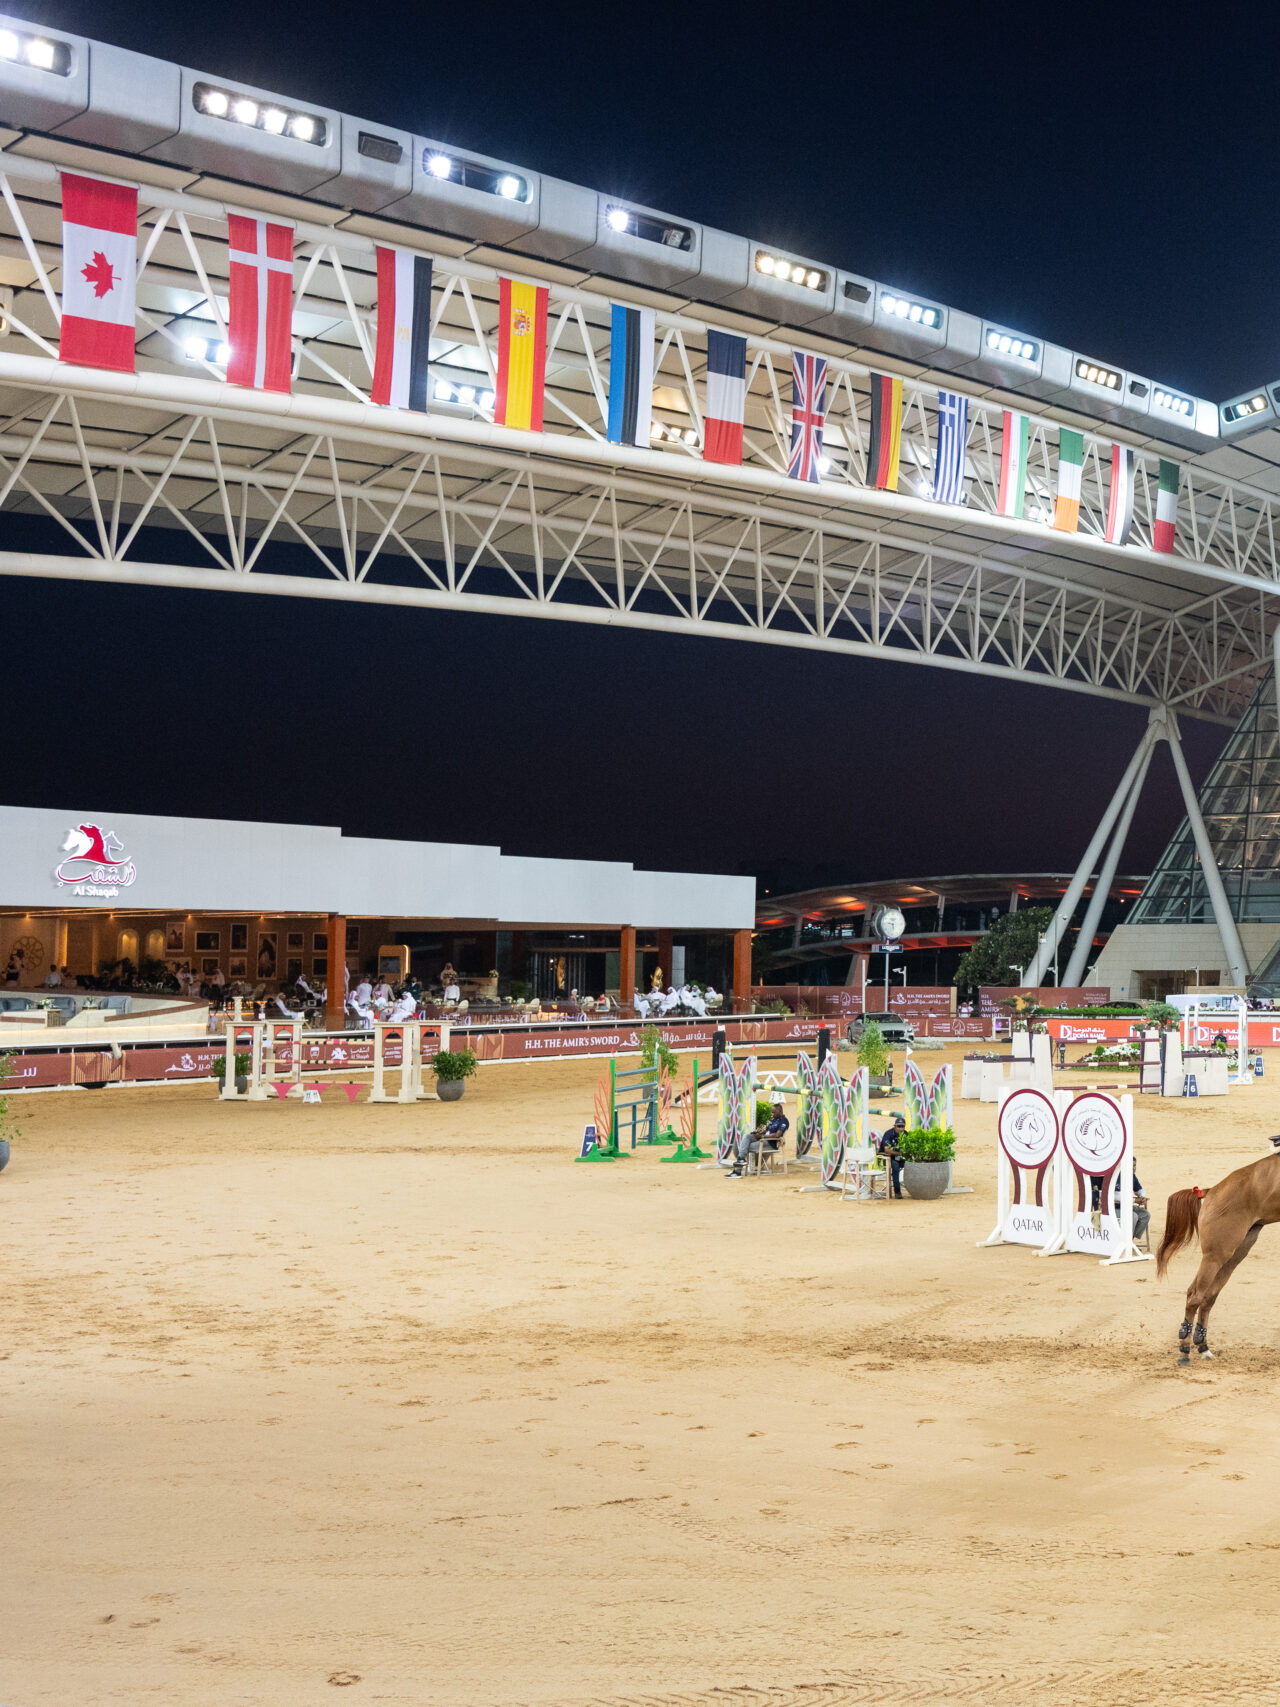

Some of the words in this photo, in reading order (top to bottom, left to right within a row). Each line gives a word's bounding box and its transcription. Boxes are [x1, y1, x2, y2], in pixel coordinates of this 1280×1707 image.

[73, 886, 84, 896] Al
[86, 886, 119, 898] Shaqab
[525, 1040, 543, 1049] H.H.
[544, 1039, 561, 1048] THE
[590, 1035, 620, 1046] SWORD
[1190, 1085, 1196, 1093] 6
[586, 1142, 593, 1152] 7
[1013, 1217, 1044, 1232] QATAR
[1077, 1225, 1110, 1242] QATAR
